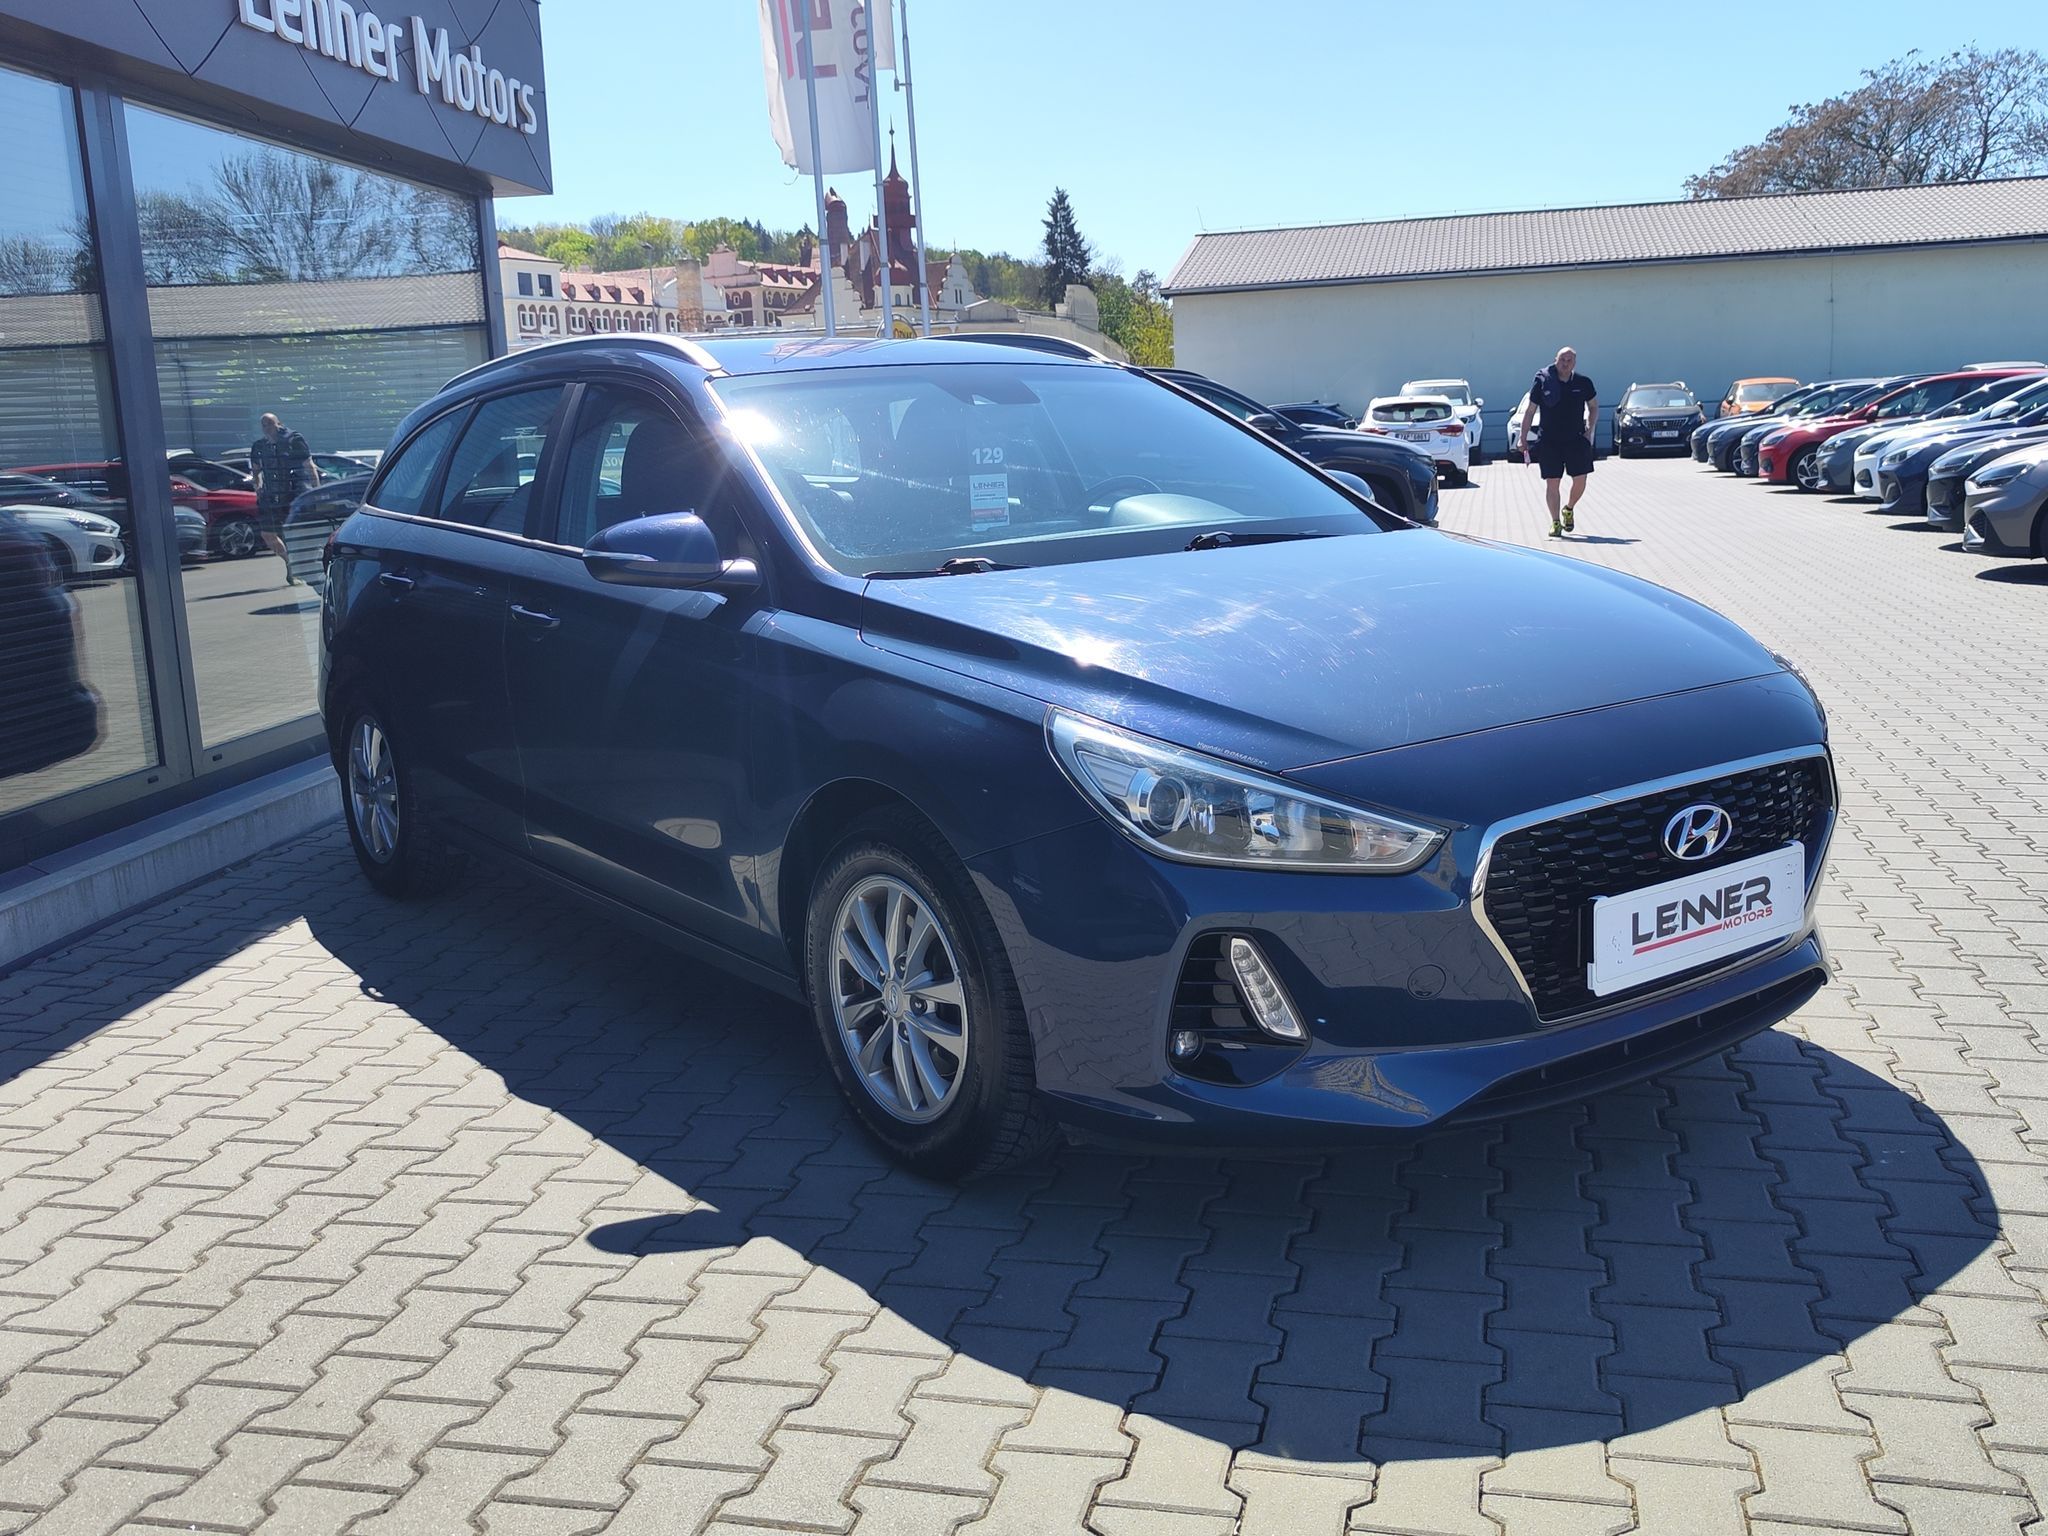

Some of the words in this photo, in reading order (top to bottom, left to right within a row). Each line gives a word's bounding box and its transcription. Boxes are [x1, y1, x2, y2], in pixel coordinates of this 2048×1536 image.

[411, 15, 538, 135] Motors
[972, 447, 1004, 465] 129
[1631, 876, 1773, 946] LENNER
[1722, 906, 1773, 931] MOTORS
